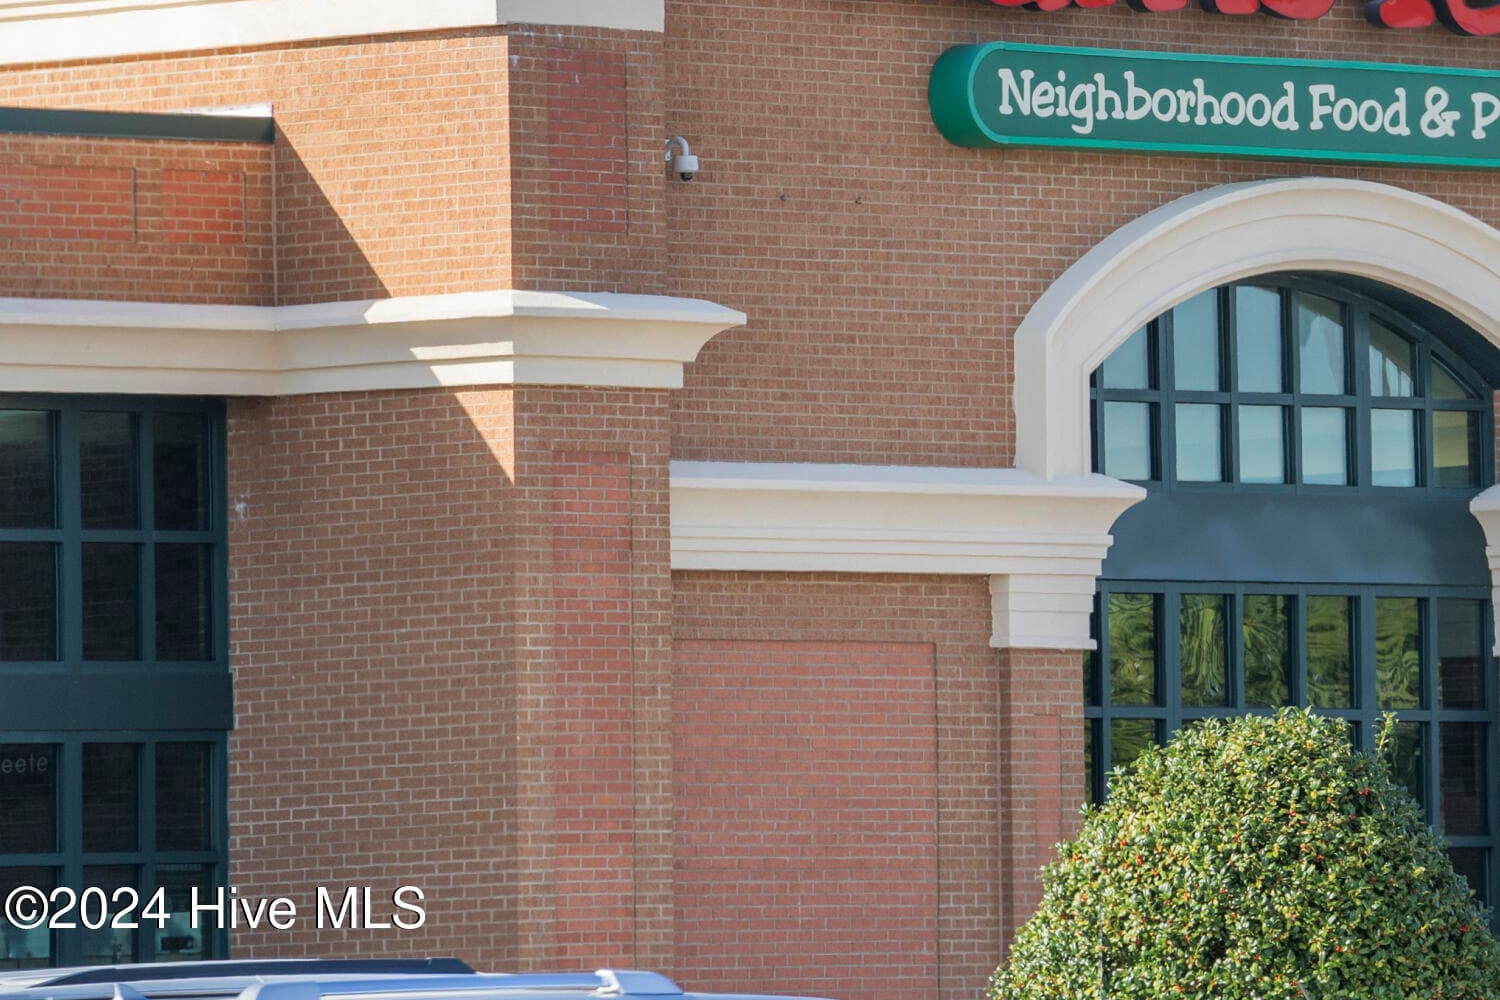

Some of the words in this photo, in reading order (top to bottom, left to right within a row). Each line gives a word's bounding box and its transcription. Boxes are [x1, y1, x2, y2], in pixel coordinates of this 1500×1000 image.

[998, 68, 1300, 135] Neighborhood
[1308, 84, 1411, 136] Food
[1420, 86, 1461, 138] &
